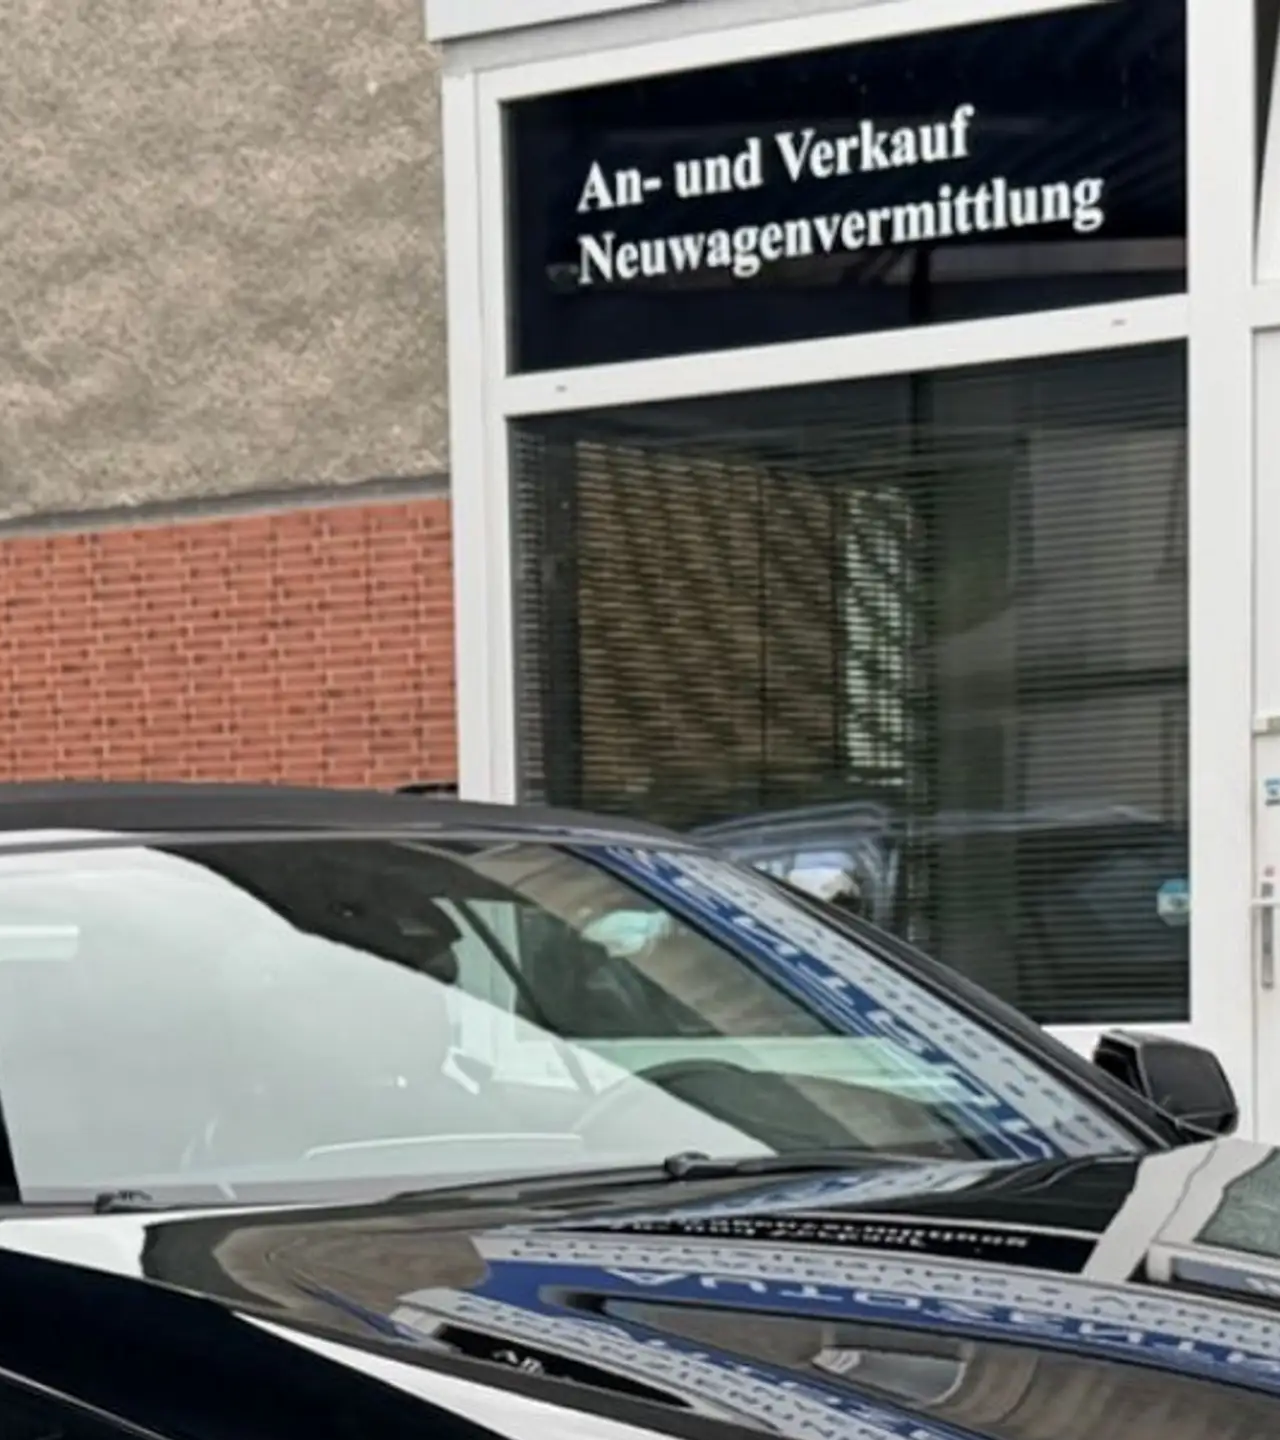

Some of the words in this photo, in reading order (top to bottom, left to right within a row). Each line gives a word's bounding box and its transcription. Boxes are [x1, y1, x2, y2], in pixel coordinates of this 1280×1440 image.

[577, 160, 662, 212] An-
[674, 136, 763, 198] und
[774, 103, 975, 182] Verkauf
[577, 177, 1104, 284] Neuwagenvermittlung
